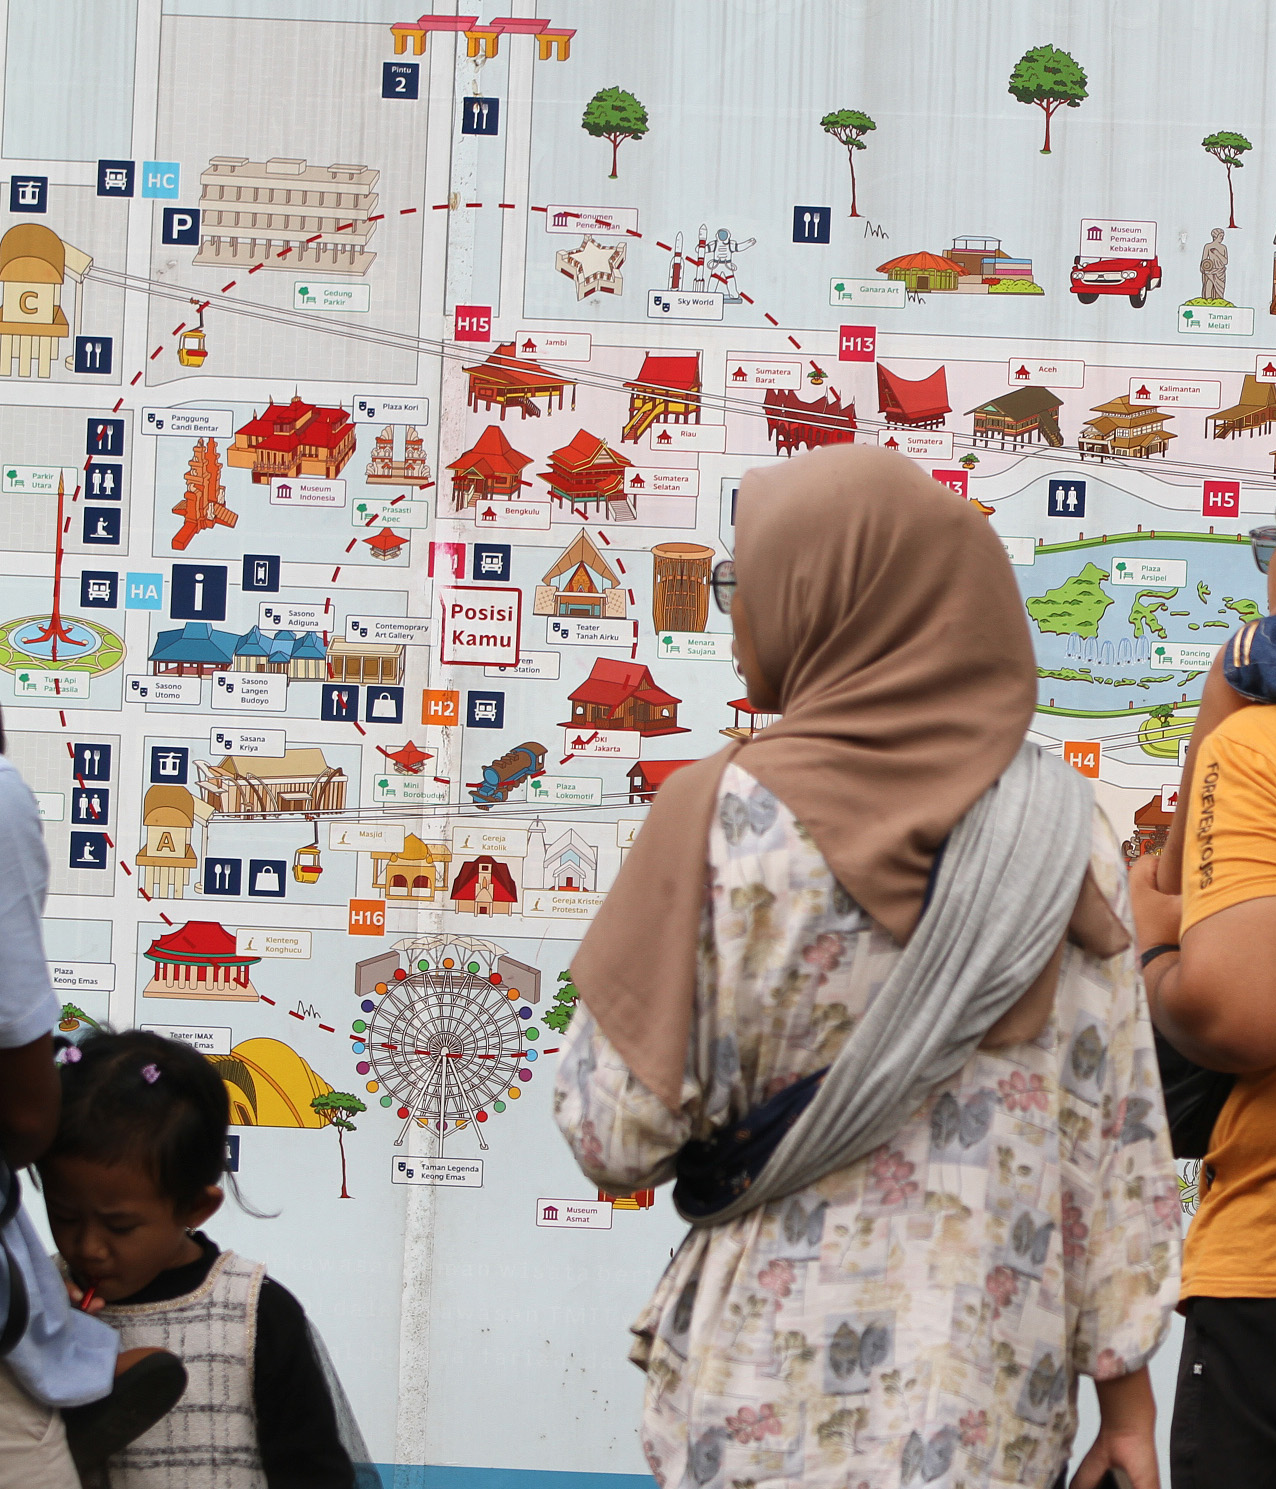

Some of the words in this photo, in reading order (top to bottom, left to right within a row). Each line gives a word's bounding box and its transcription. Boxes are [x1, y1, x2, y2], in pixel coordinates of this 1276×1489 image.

[396, 77, 406, 92] 2
[149, 174, 174, 188] HC
[173, 214, 192, 239] P
[323, 289, 353, 299] Gedung
[18, 290, 39, 315] C
[677, 297, 690, 307] Sky
[458, 317, 488, 331] H15
[842, 337, 874, 351] H13
[172, 415, 209, 423] Panggung
[1210, 492, 1234, 507] H5
[383, 505, 411, 513] Prasasti
[131, 584, 158, 599] HA
[451, 604, 512, 621] Posisi
[376, 623, 428, 633] Contemoprary
[389, 632, 414, 640] Gallery
[453, 631, 511, 647] Kamu
[1179, 649, 1211, 658] Dancing
[514, 666, 541, 674] Station
[241, 697, 269, 705] Budoyo
[430, 700, 455, 717] H2
[1070, 753, 1095, 767] H4
[157, 832, 176, 853] A
[552, 906, 588, 914] Protestan
[352, 911, 385, 927] H16
[266, 936, 299, 945] Klenteng
[266, 946, 302, 954] Konghucu
[54, 977, 76, 985] Keong
[446, 1166, 479, 1175] Legenda
[421, 1173, 443, 1181] Keong
[446, 1172, 465, 1180] Emas
